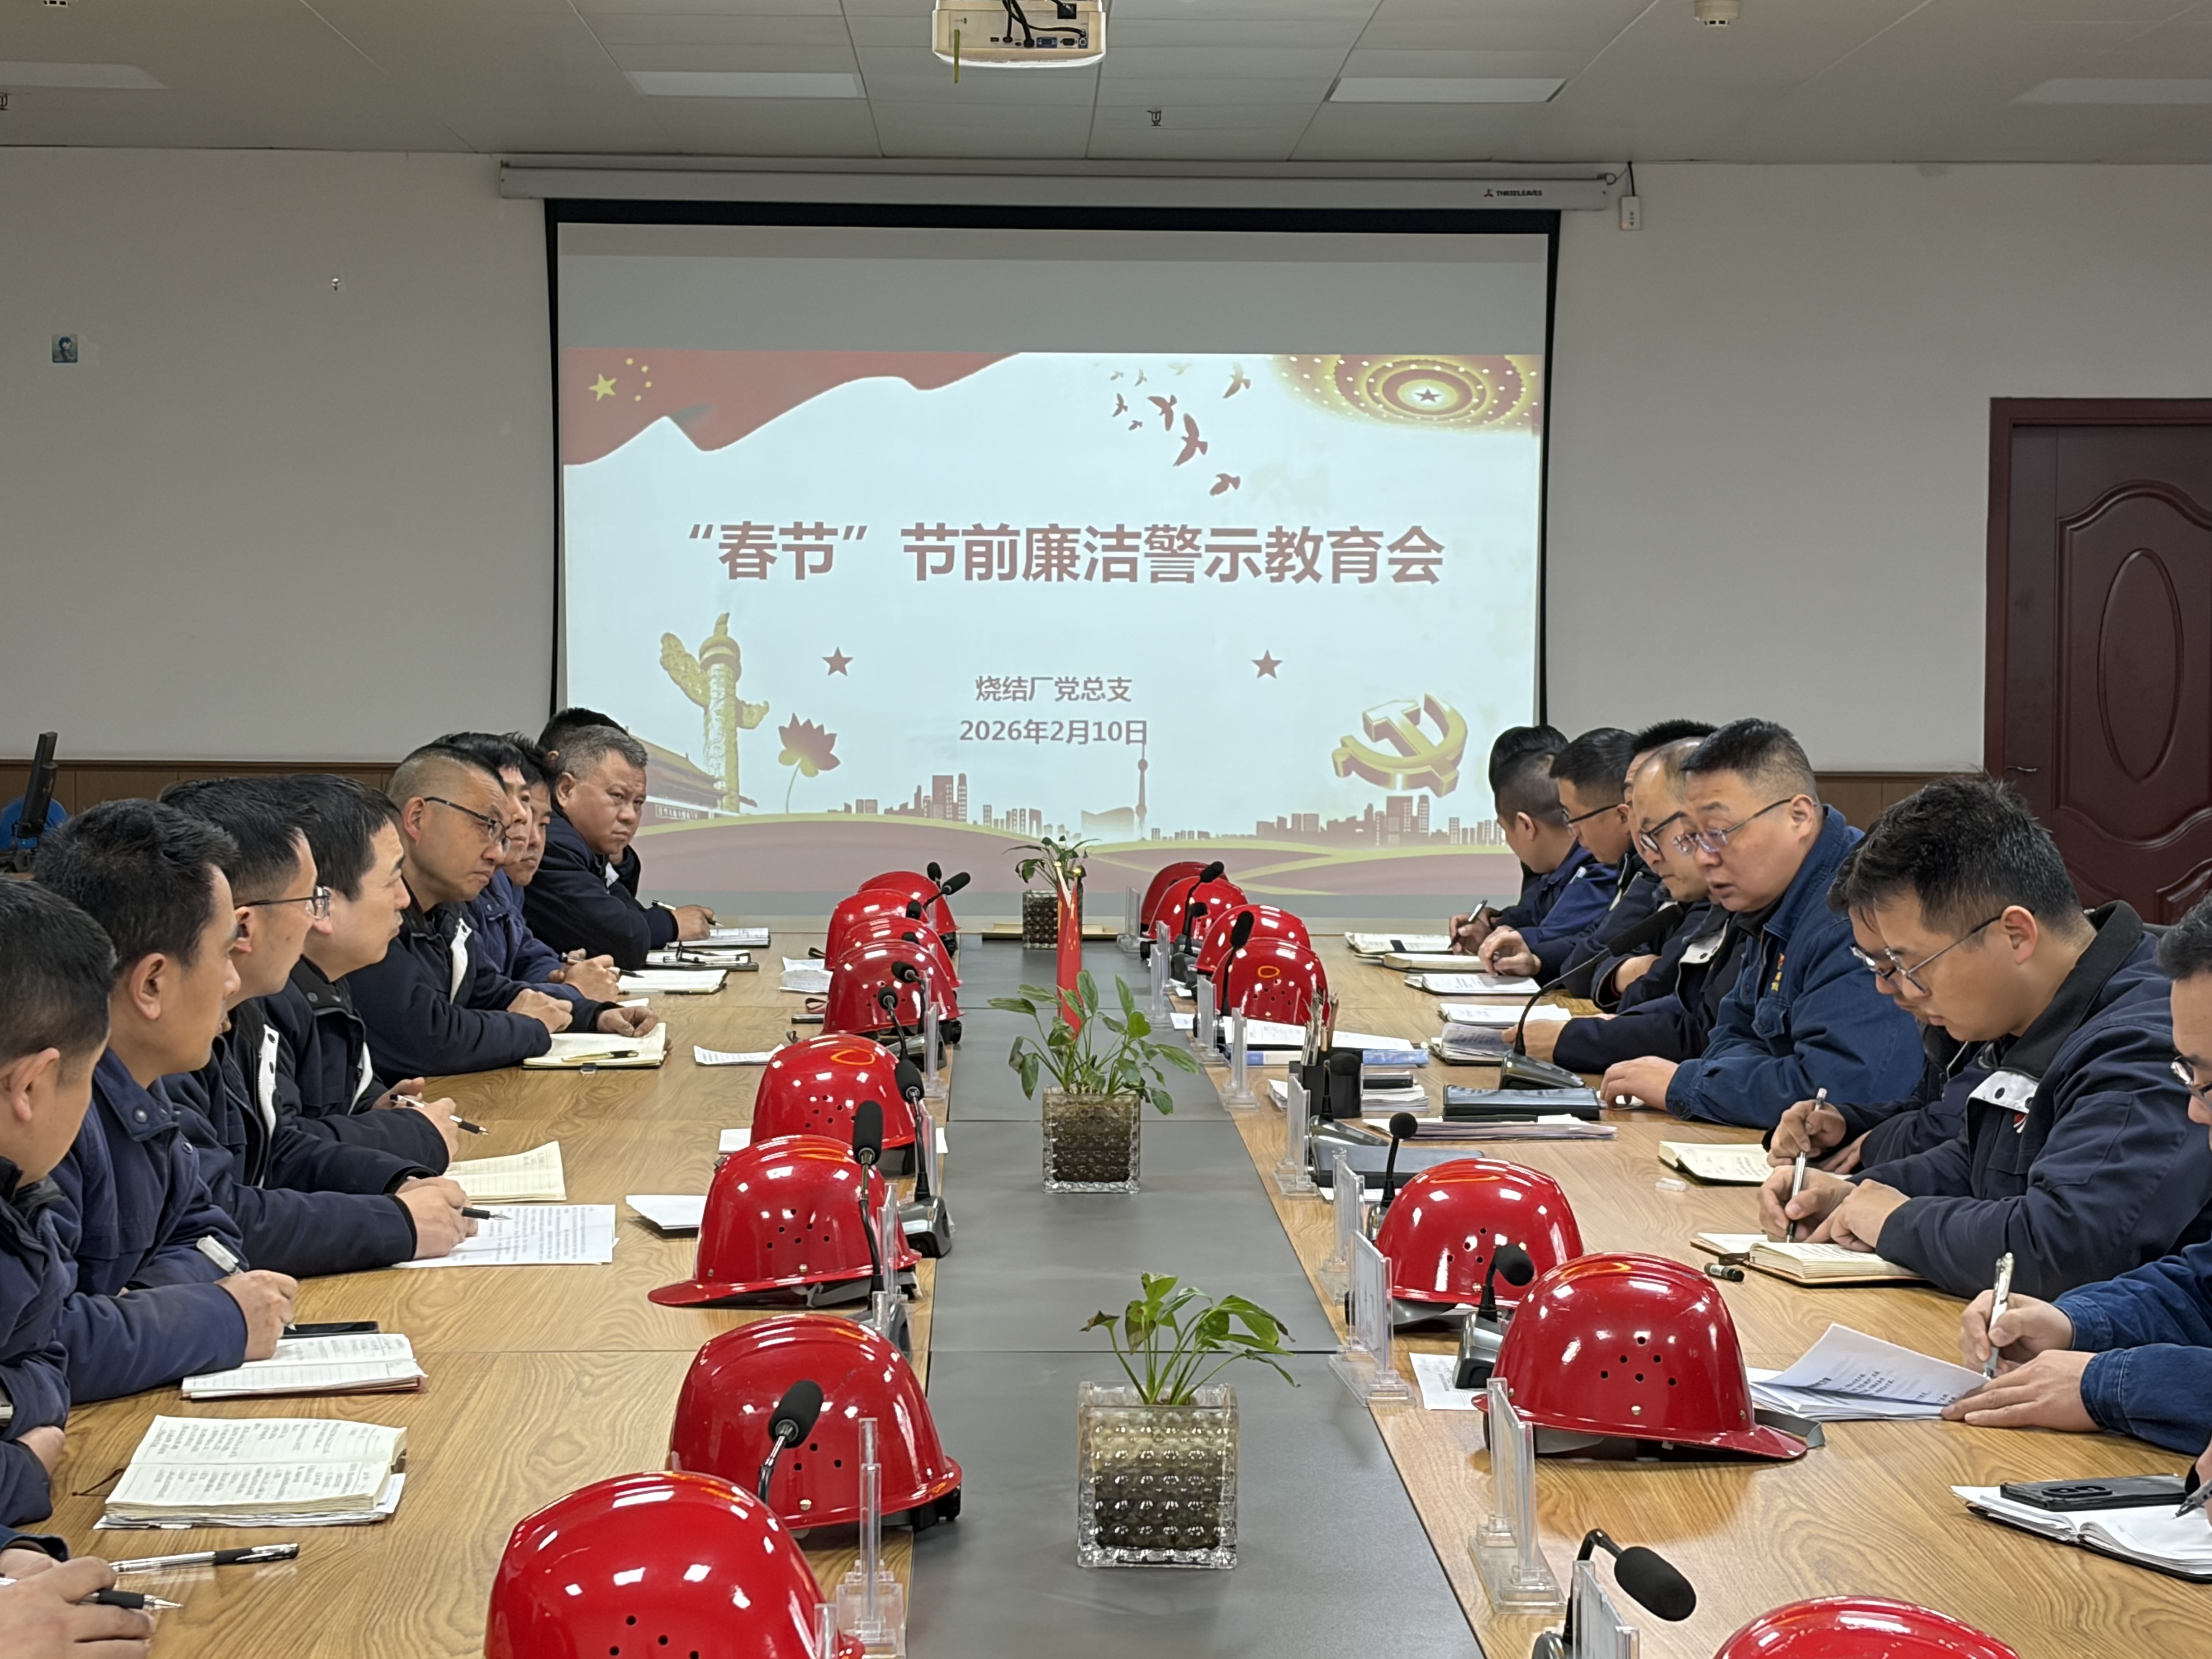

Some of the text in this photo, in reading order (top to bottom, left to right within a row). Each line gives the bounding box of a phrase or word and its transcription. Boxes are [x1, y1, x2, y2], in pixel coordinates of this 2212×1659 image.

[975, 675, 1132, 702] 烧结厂党总支
[960, 719, 1147, 745] 2026年2月10日
